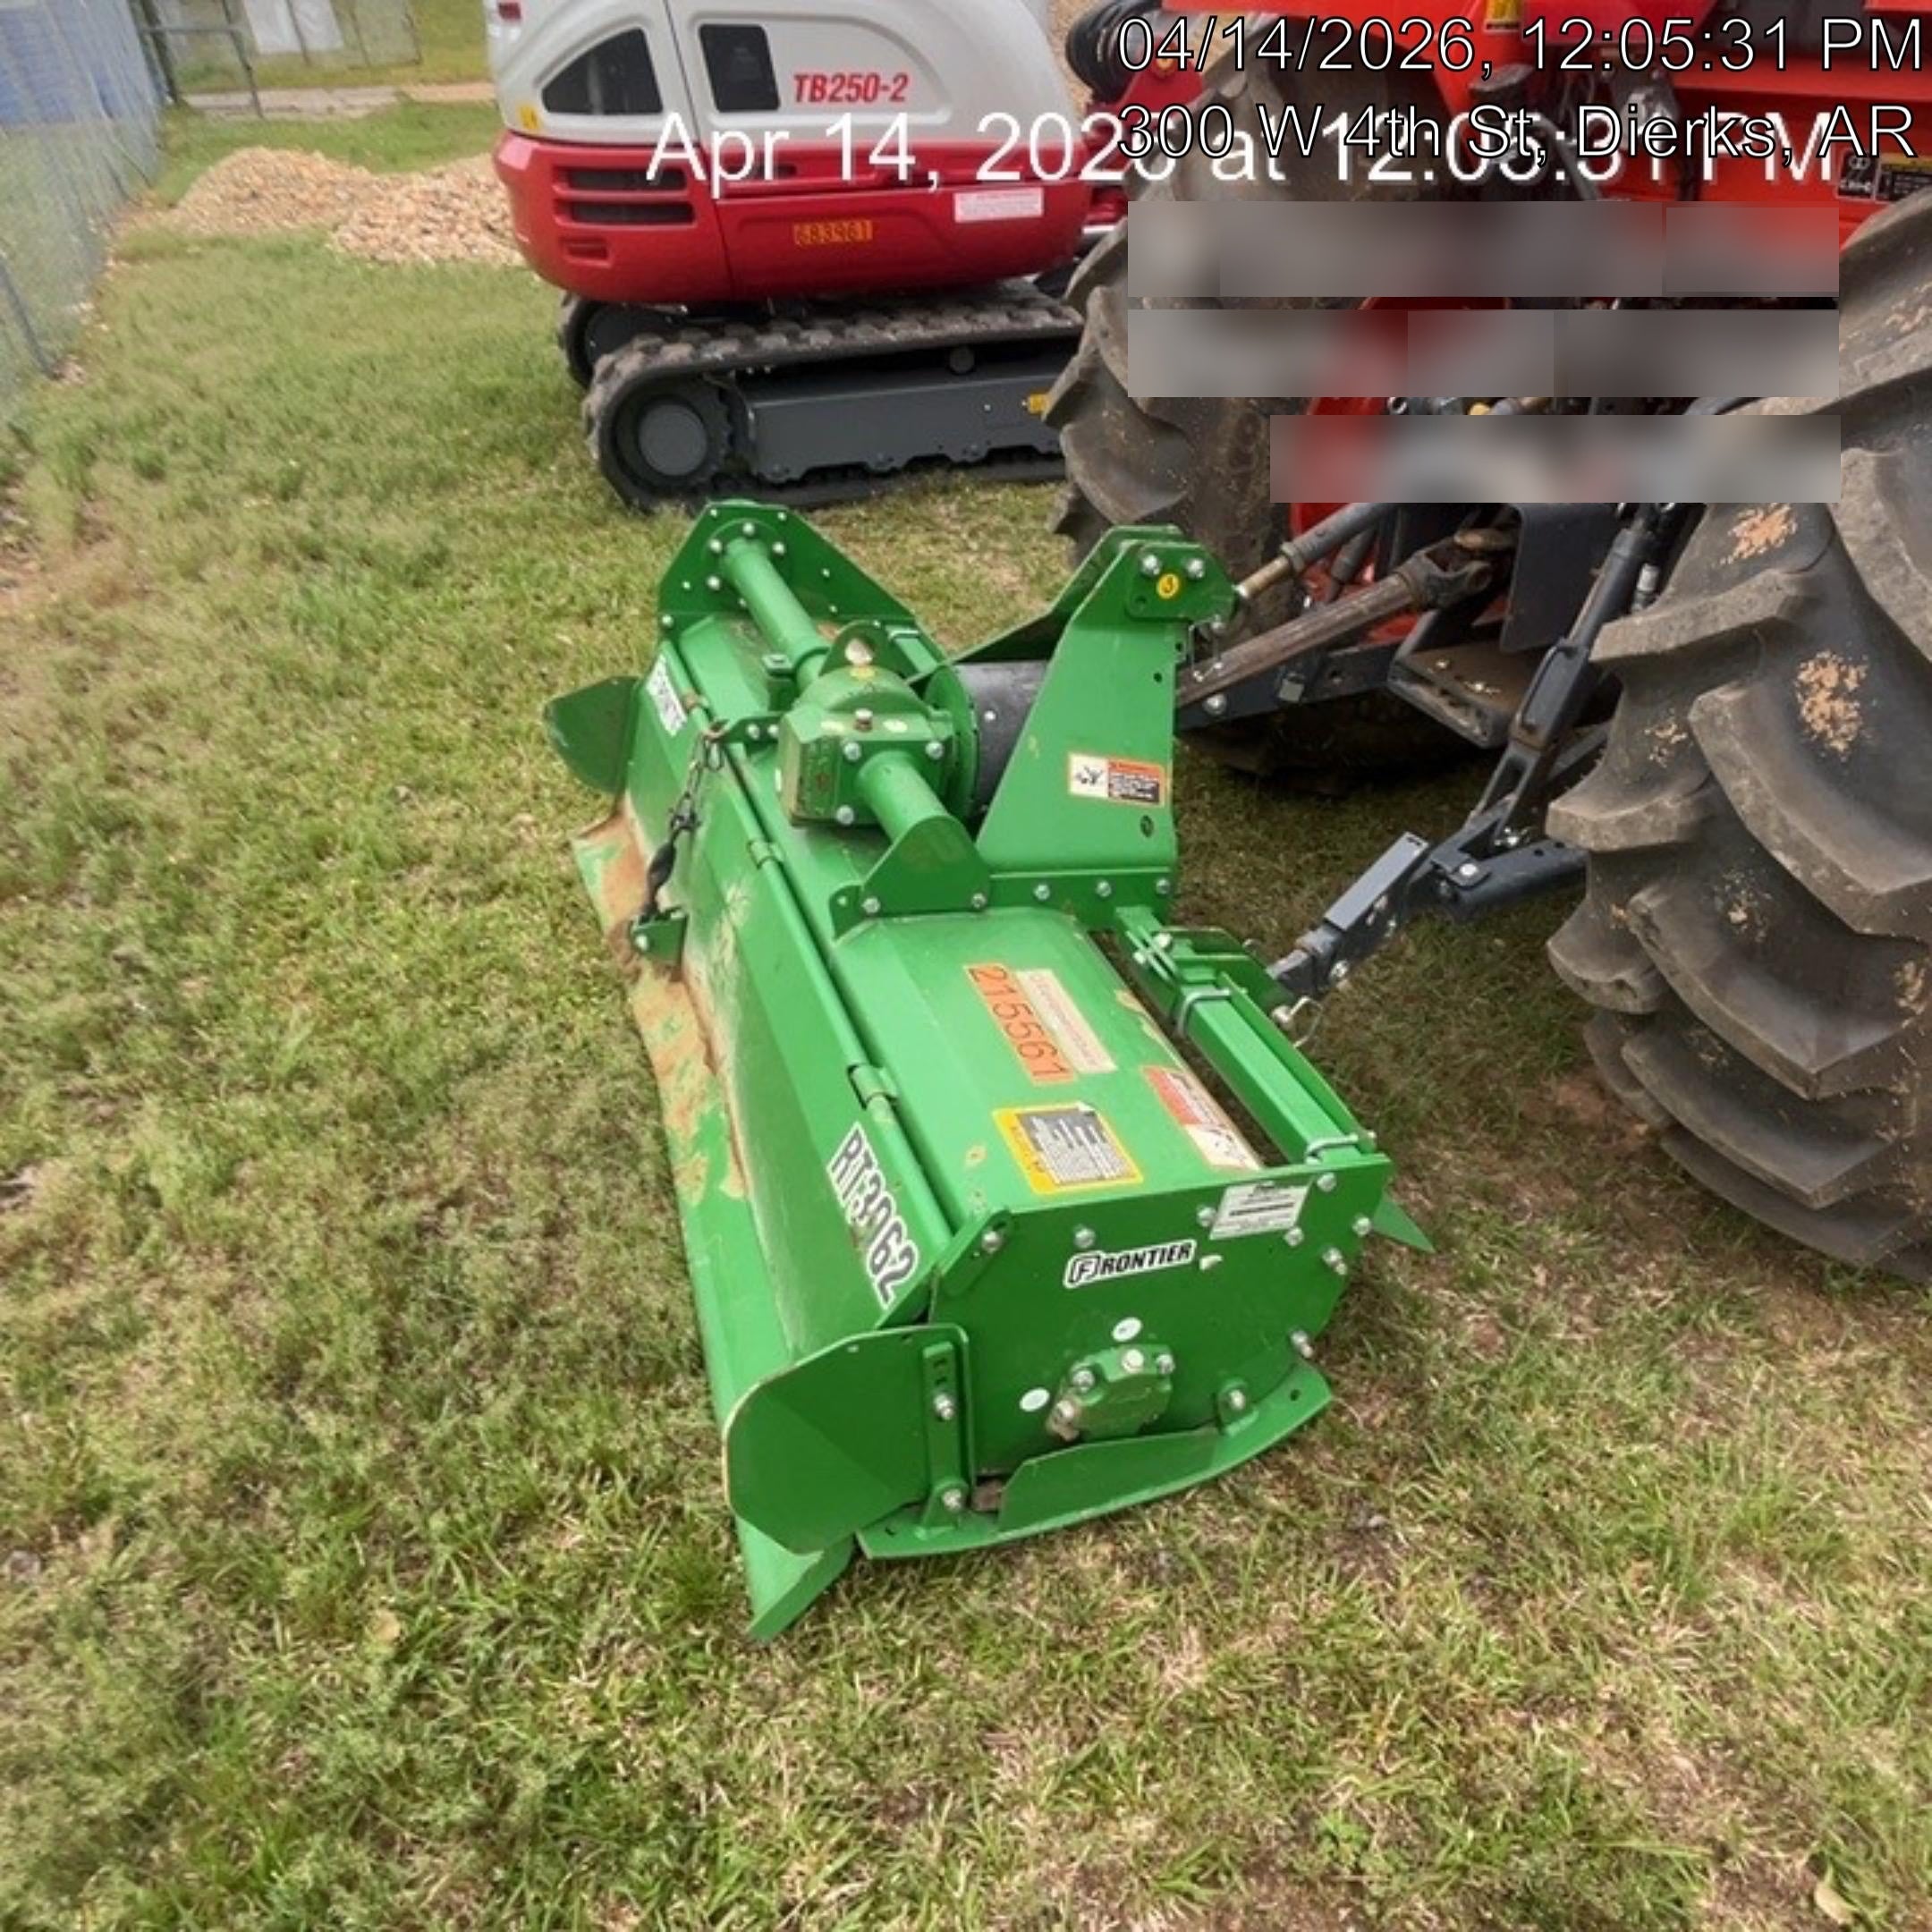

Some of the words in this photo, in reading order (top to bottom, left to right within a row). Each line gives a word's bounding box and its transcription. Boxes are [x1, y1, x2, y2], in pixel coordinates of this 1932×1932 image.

[793, 72, 909, 103] TB250-2
[968, 965, 1071, 1077] 215561
[1068, 1241, 1194, 1285] FRONTIER
